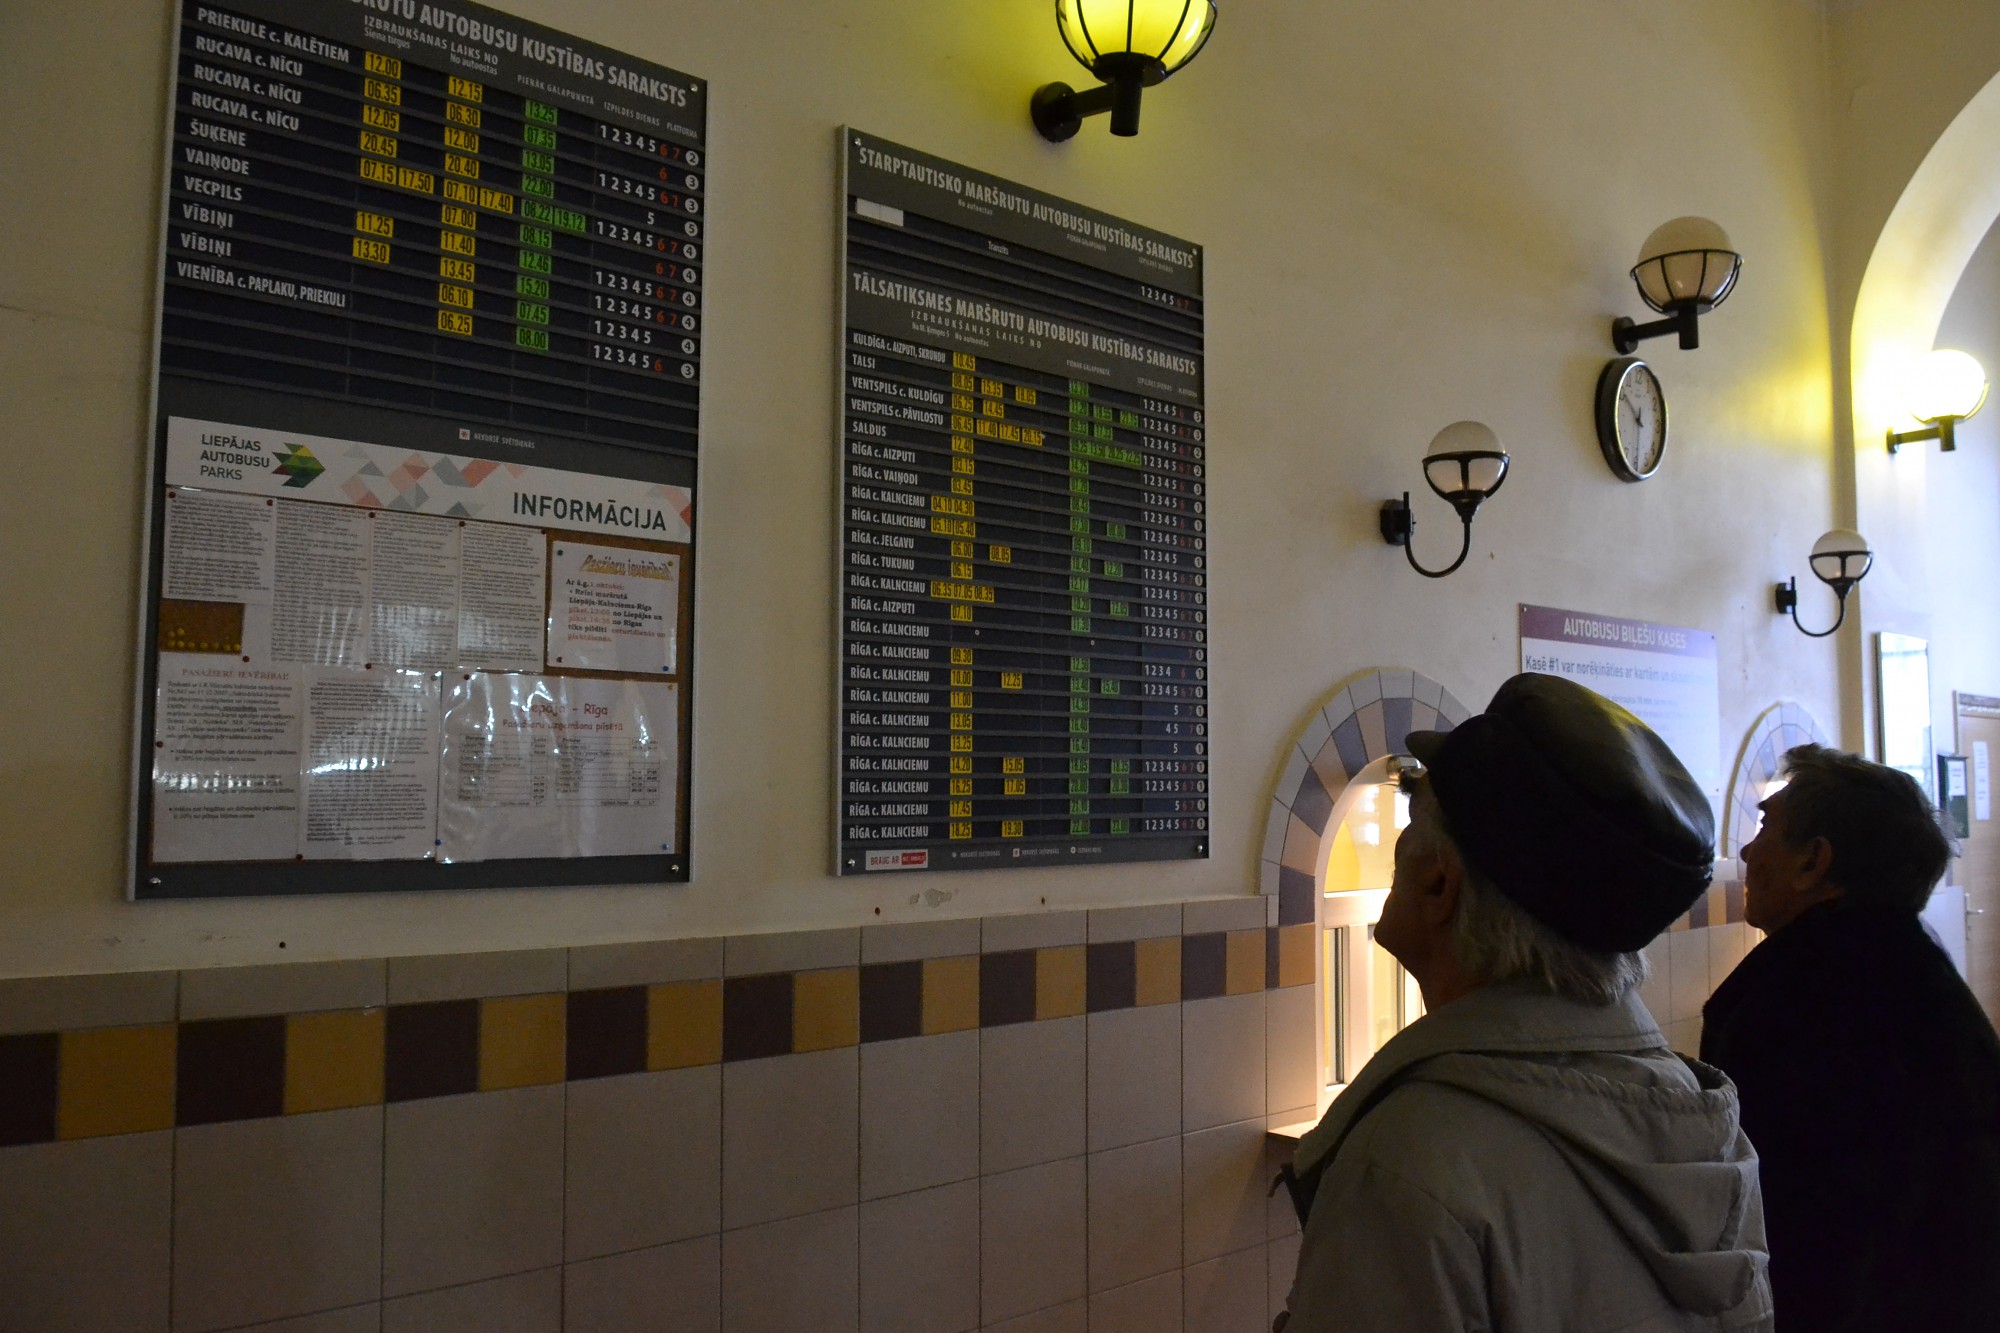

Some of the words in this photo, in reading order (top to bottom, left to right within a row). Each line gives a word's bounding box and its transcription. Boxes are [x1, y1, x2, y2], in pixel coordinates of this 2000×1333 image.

[364, 15, 447, 49] IZBRAUKŠANAS
[451, 41, 481, 60] LAIKS
[484, 53, 498, 65] NO
[197, 7, 266, 40] PRIEKULE
[269, 30, 280, 42] c.
[284, 32, 350, 63] KALĒTIEM
[369, 54, 398, 77] 12.00
[452, 78, 481, 100] 12.15
[528, 101, 555, 122] 13.25
[420, 4, 518, 52] AUTOBUSU
[522, 37, 604, 81] KUSTĪBAS
[608, 66, 686, 107] SARAKSTS
[195, 36, 252, 63] RUCAVA
[255, 54, 266, 67] c.
[270, 54, 303, 76] NĪCU
[367, 80, 398, 103] 06.35
[450, 103, 479, 126] 06.30
[526, 126, 554, 147] 07.35
[194, 64, 250, 92] RUCAVA
[253, 82, 265, 95] c.
[268, 83, 302, 105] NĪCU
[366, 107, 397, 130] 12.05
[448, 129, 477, 151] 12.00
[526, 150, 552, 172] 13.05
[192, 91, 249, 120] RUCAVA
[251, 110, 263, 123] c.
[266, 109, 299, 132] NĪCU
[364, 133, 395, 156] 20.45
[447, 154, 477, 177] 20.40
[525, 175, 553, 197] 22.00
[190, 118, 247, 147] ŠUĶENE
[363, 160, 394, 183] 07.15
[402, 170, 431, 192] 17.50
[446, 182, 476, 203] 07.10
[482, 190, 512, 212] 17.40
[524, 200, 551, 223] 08.22
[558, 209, 584, 231] 19.12
[185, 147, 250, 176] VAIŅODE
[444, 207, 474, 228] 07.00
[523, 224, 550, 246] 08.15
[859, 146, 962, 194] STARPTAUTISKO
[965, 180, 1030, 216] MARŠRUTU
[1033, 202, 1091, 236] AUTOBUSU
[1094, 222, 1144, 254] KUSTĪBAS
[1146, 240, 1194, 270] SARAKSTS
[184, 175, 242, 202] VECPILS
[361, 213, 390, 235] 11.25
[444, 232, 473, 254] 11.40
[523, 250, 549, 272] 12.46
[182, 203, 233, 229] VĪBIŅI
[357, 239, 387, 262] 13.30
[443, 258, 473, 281] 13.45
[521, 275, 547, 298] 15.20
[180, 232, 232, 258] VĪBIŅI
[441, 285, 469, 307] 06.10
[519, 301, 547, 323] 07.45
[177, 261, 235, 287] VIENĪBA
[237, 275, 247, 288] c.
[248, 276, 298, 300] PAPLAKU,
[300, 286, 346, 308] PRIEKULI
[440, 311, 470, 333] 06.25
[519, 327, 546, 349] 08.00
[853, 271, 952, 313] TĀLSATIKSMES
[956, 298, 1024, 332] MARŠRUTU
[1028, 317, 1089, 348] AUTOBUSU
[1092, 334, 1144, 363] KUSTĪBAS
[1147, 351, 1196, 376] SARAKSTS
[853, 332, 886, 351] KULDĪGA
[893, 341, 917, 358] AIZPUTI,
[918, 347, 946, 363] SKRUNDU
[853, 353, 876, 369] TALSI
[852, 376, 897, 396] VENTSPILS
[908, 387, 944, 404] KULDĪGU
[851, 398, 894, 416] VENTSPILS
[903, 408, 944, 425] PĀVILOSTU
[202, 434, 261, 452] LIEPĀJAS
[853, 423, 887, 437] SALDUS
[201, 451, 269, 468] AUTOBUSU
[852, 442, 873, 457] RĪGA
[883, 446, 916, 463] AIZPUTI
[201, 465, 242, 480] PARKS
[852, 464, 873, 479] RĪGA
[884, 469, 918, 485] VAIŅODI
[852, 486, 871, 500] RĪGA
[881, 489, 925, 508] KALNCIEMU
[514, 492, 666, 530] INFORMĀCIJA
[852, 508, 871, 522] RĪGA
[881, 511, 926, 529] KALNCIEMU
[852, 529, 871, 544] RĪGA
[880, 533, 914, 549] JELGAVU
[851, 552, 871, 566] RĪGA
[881, 556, 915, 570] TUKUMU
[851, 574, 870, 588] RĪGA
[881, 579, 926, 594] KALNCIEMU
[851, 597, 871, 611] RĪGA
[883, 602, 915, 614] AIZPUTI
[1564, 618, 1619, 641] AUTOBUSU
[1622, 624, 1656, 647] BIĻEŠU
[1658, 630, 1687, 648] KASES
[1526, 655, 1547, 671] Kasē
[1549, 658, 1559, 671] #1
[1562, 661, 1574, 672] var
[584, 703, 608, 718] Rīga
[850, 711, 871, 725] RĪGA
[882, 714, 929, 727] KALNCIEMU
[850, 825, 871, 839] RĪGA
[881, 826, 928, 838] KALNCIEMU
